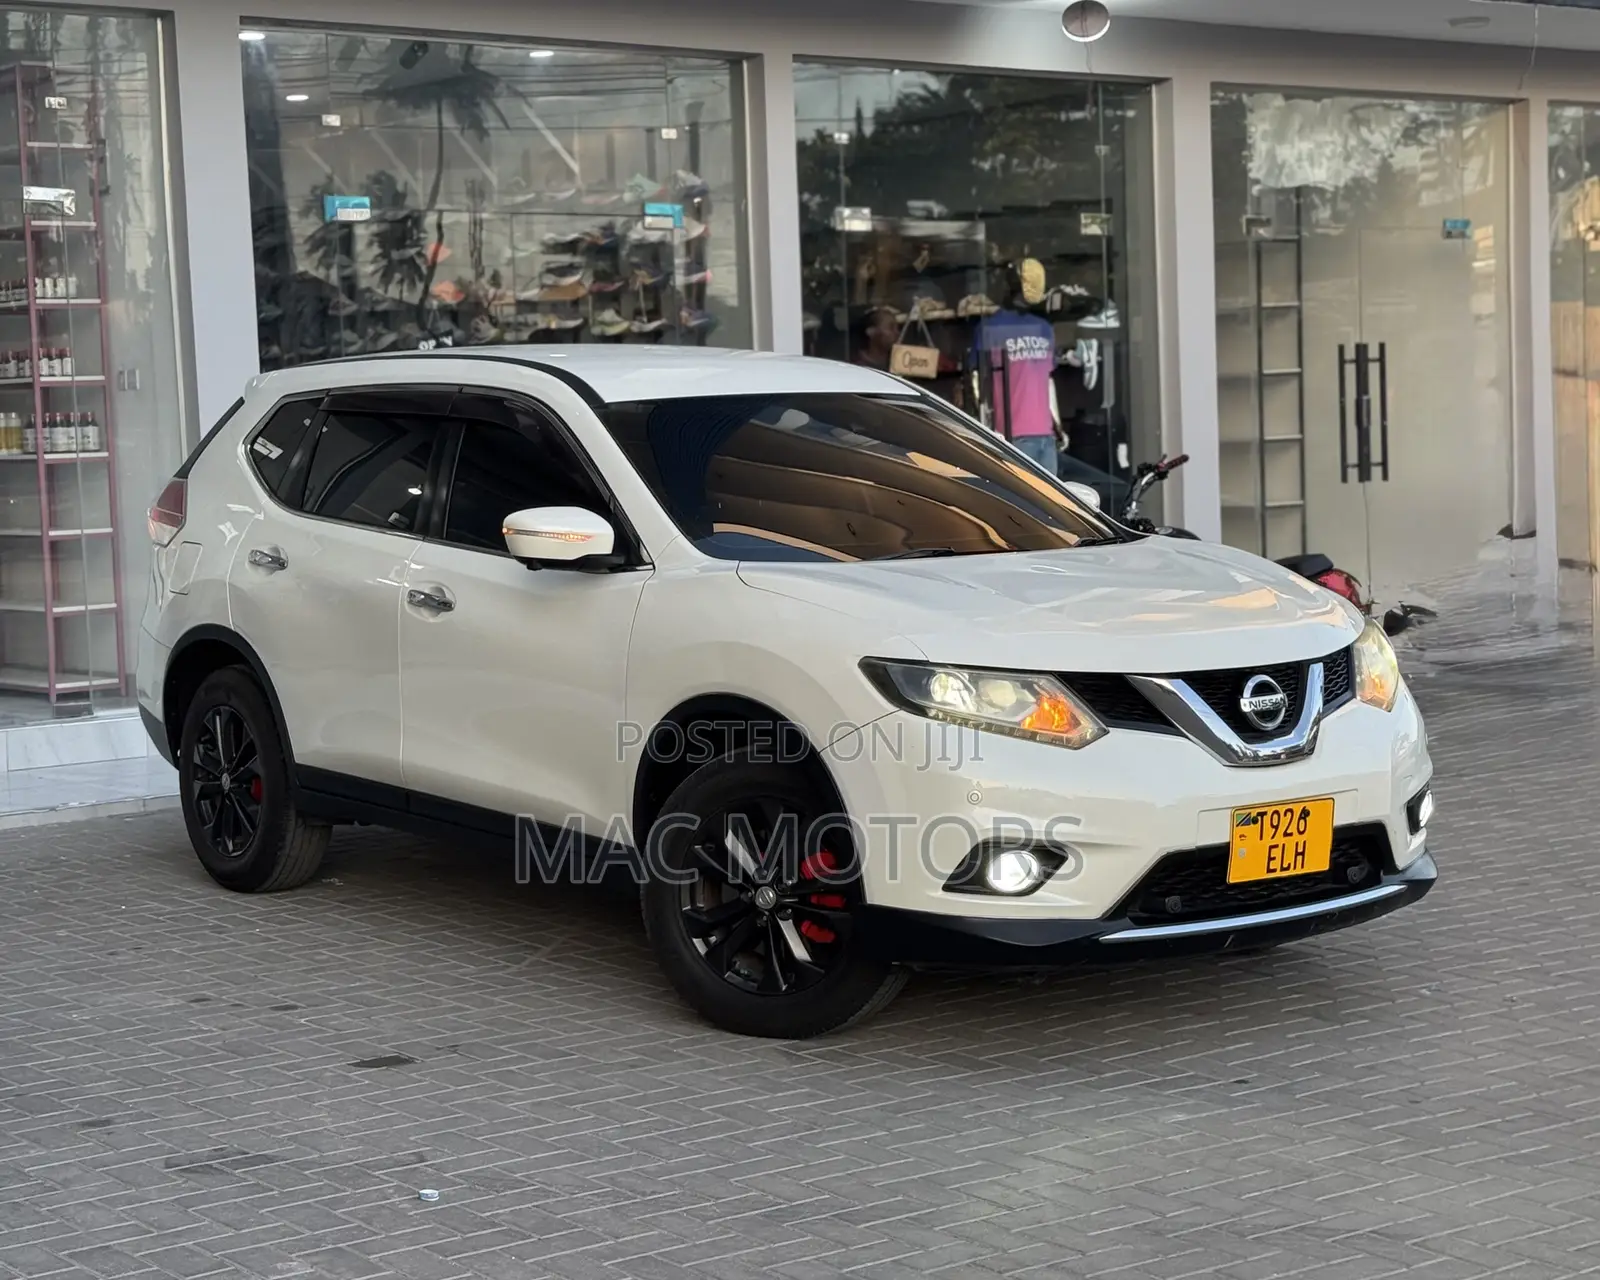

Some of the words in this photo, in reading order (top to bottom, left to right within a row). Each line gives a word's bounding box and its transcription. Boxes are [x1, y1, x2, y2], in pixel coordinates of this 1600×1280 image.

[418, 335, 453, 350] OPN
[902, 350, 930, 372] Open
[1249, 697, 1286, 709] NISSAN
[1256, 805, 1308, 842] T926
[1266, 840, 1307, 874] ELH
